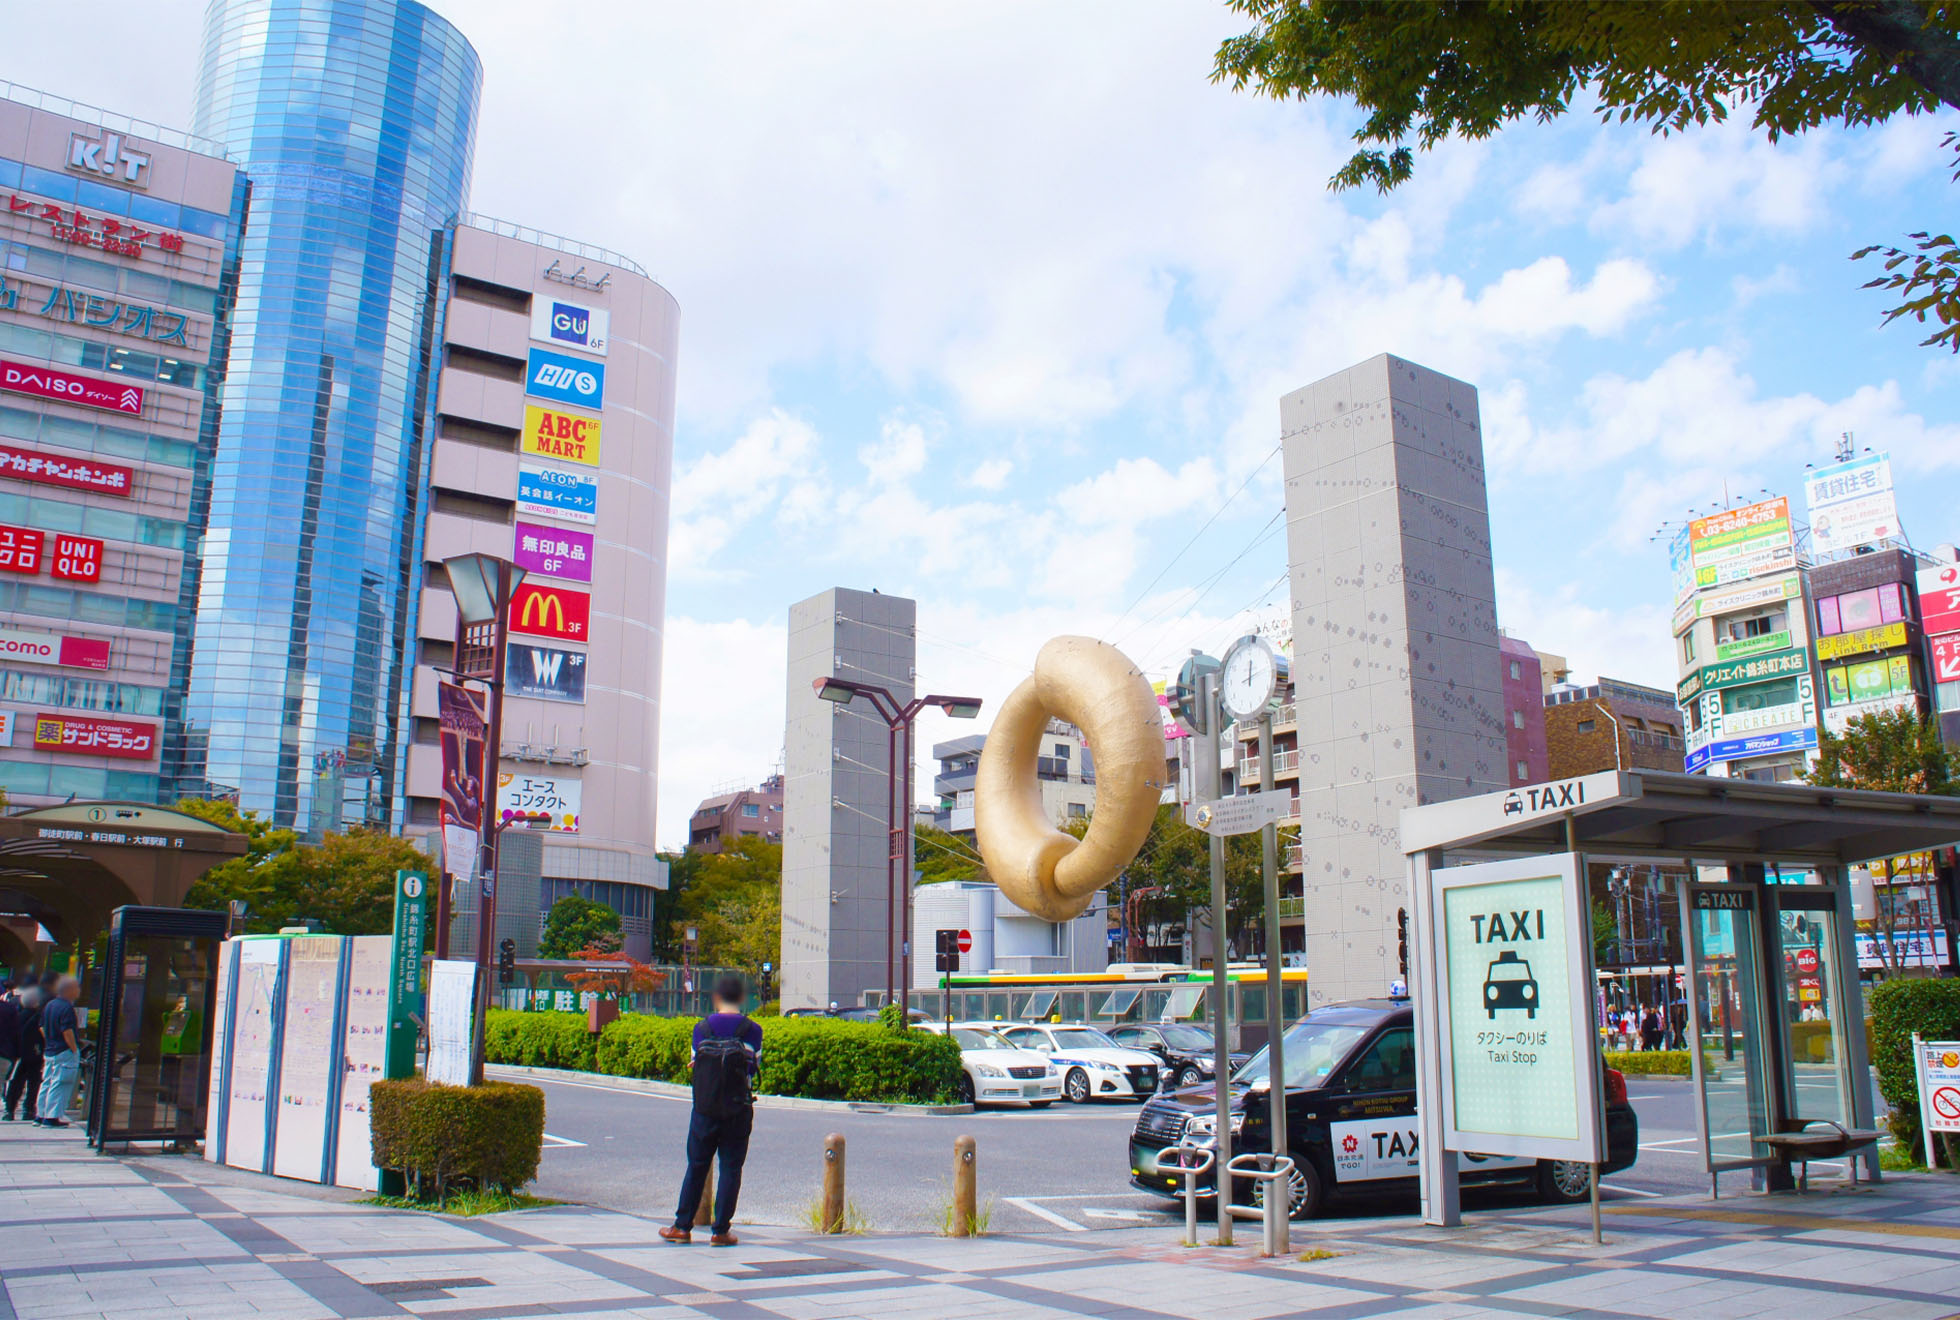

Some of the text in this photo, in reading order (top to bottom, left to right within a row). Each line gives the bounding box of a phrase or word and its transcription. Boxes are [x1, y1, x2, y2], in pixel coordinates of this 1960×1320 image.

[9, 194, 184, 254] レストラン街
[40, 285, 189, 347] パシオス
[554, 312, 588, 336] GU
[590, 338, 604, 349] 6F
[6, 369, 84, 395] DAISO
[538, 411, 587, 443] ABC
[536, 436, 586, 459] MART
[541, 470, 577, 487] AEON
[520, 485, 594, 507] 英会話イーオン
[60, 540, 95, 559] UNI
[521, 534, 586, 561] 無印良品
[58, 558, 96, 576] QLO
[543, 560, 562, 572] 6F
[568, 622, 582, 633] 3F
[569, 654, 584, 666] 3F
[1892, 665, 1908, 681] 5F
[39, 721, 60, 742] 薬
[63, 728, 151, 751] サンドラッグ
[522, 779, 555, 794] エース
[510, 792, 567, 810] コンタクト
[1527, 781, 1585, 812] TAXI
[1711, 893, 1744, 908] TAXI
[1470, 909, 1545, 944] TAXI
[1477, 1031, 1547, 1046] タクシーのりば
[1488, 1050, 1537, 1067] Taxi Stop
